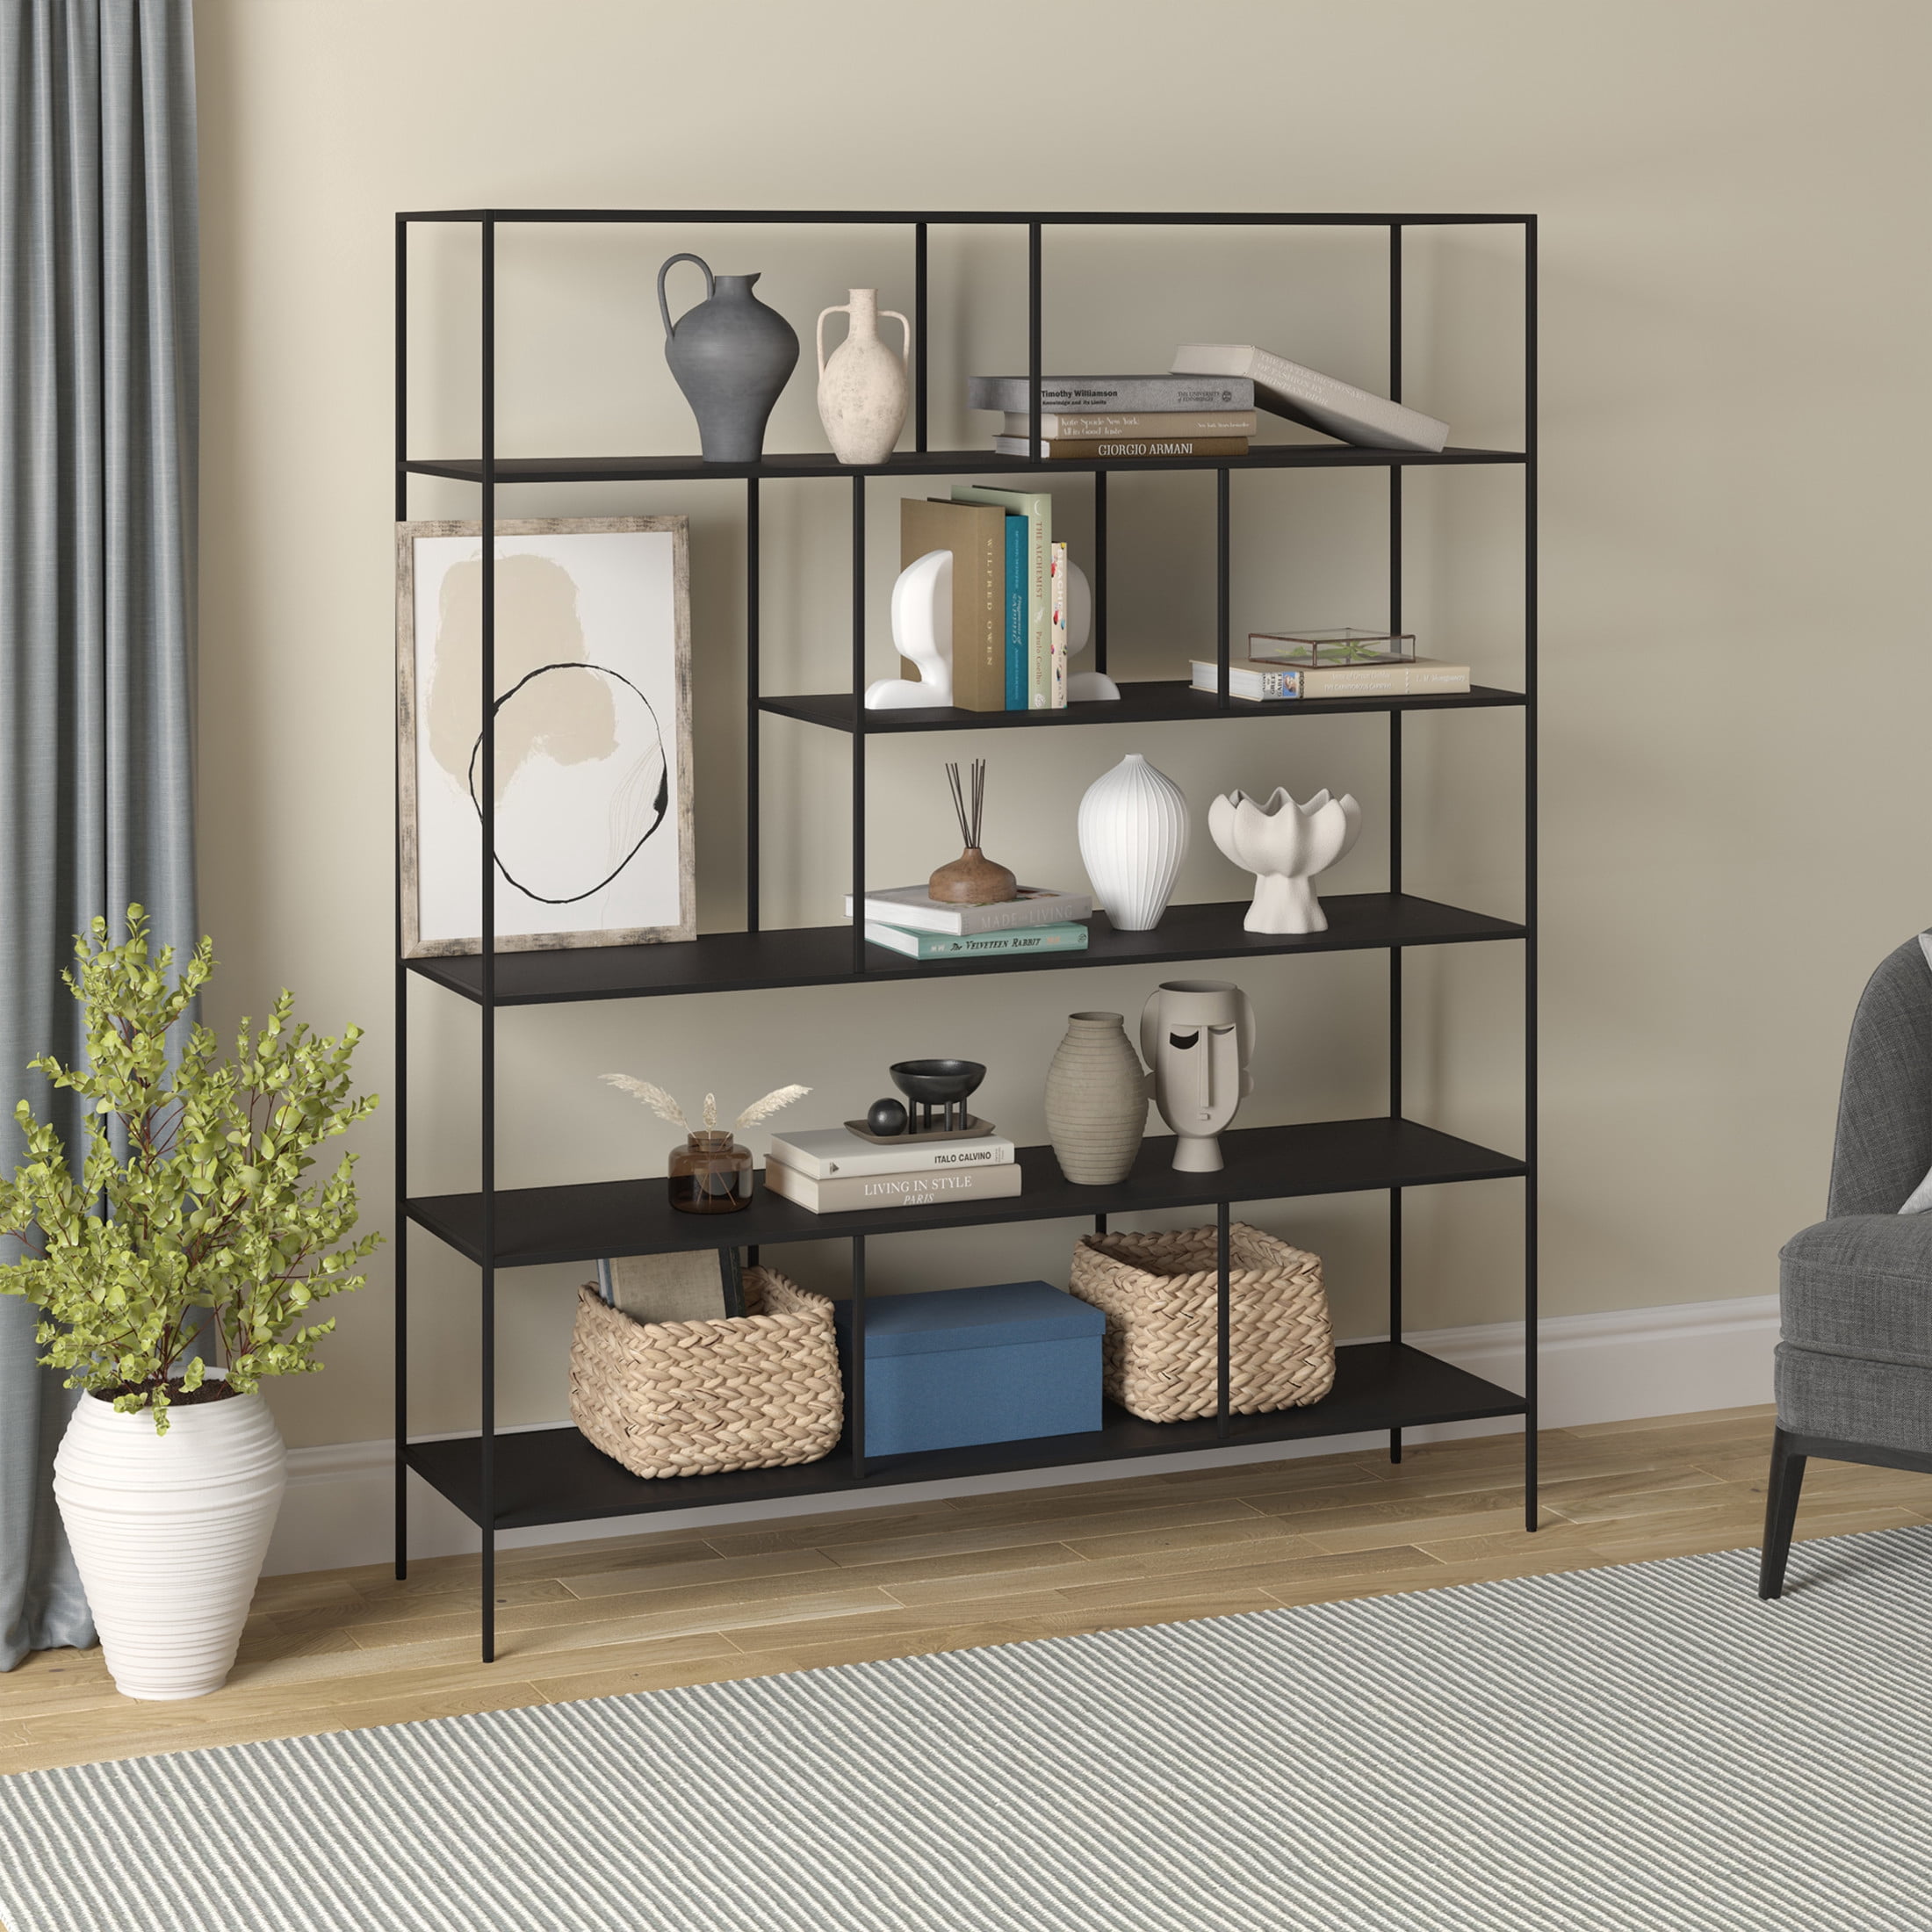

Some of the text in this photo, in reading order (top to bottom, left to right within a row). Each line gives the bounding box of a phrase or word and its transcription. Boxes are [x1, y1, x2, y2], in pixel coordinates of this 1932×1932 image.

[1042, 389, 1118, 399] Timothy Williamson
[1098, 443, 1193, 456] GIORGIO ARMANI
[982, 913, 1018, 929] MADE
[1029, 905, 1073, 924] LIVING
[950, 942, 962, 952] The
[966, 939, 1009, 950] VELVETEEN
[1012, 937, 1041, 948] RABBIT
[934, 1154, 956, 1164] ITALO
[958, 1151, 991, 1162] CALVINO
[864, 1176, 972, 1195] LIVING IN STYLE
[903, 1193, 935, 1206] PARIS
